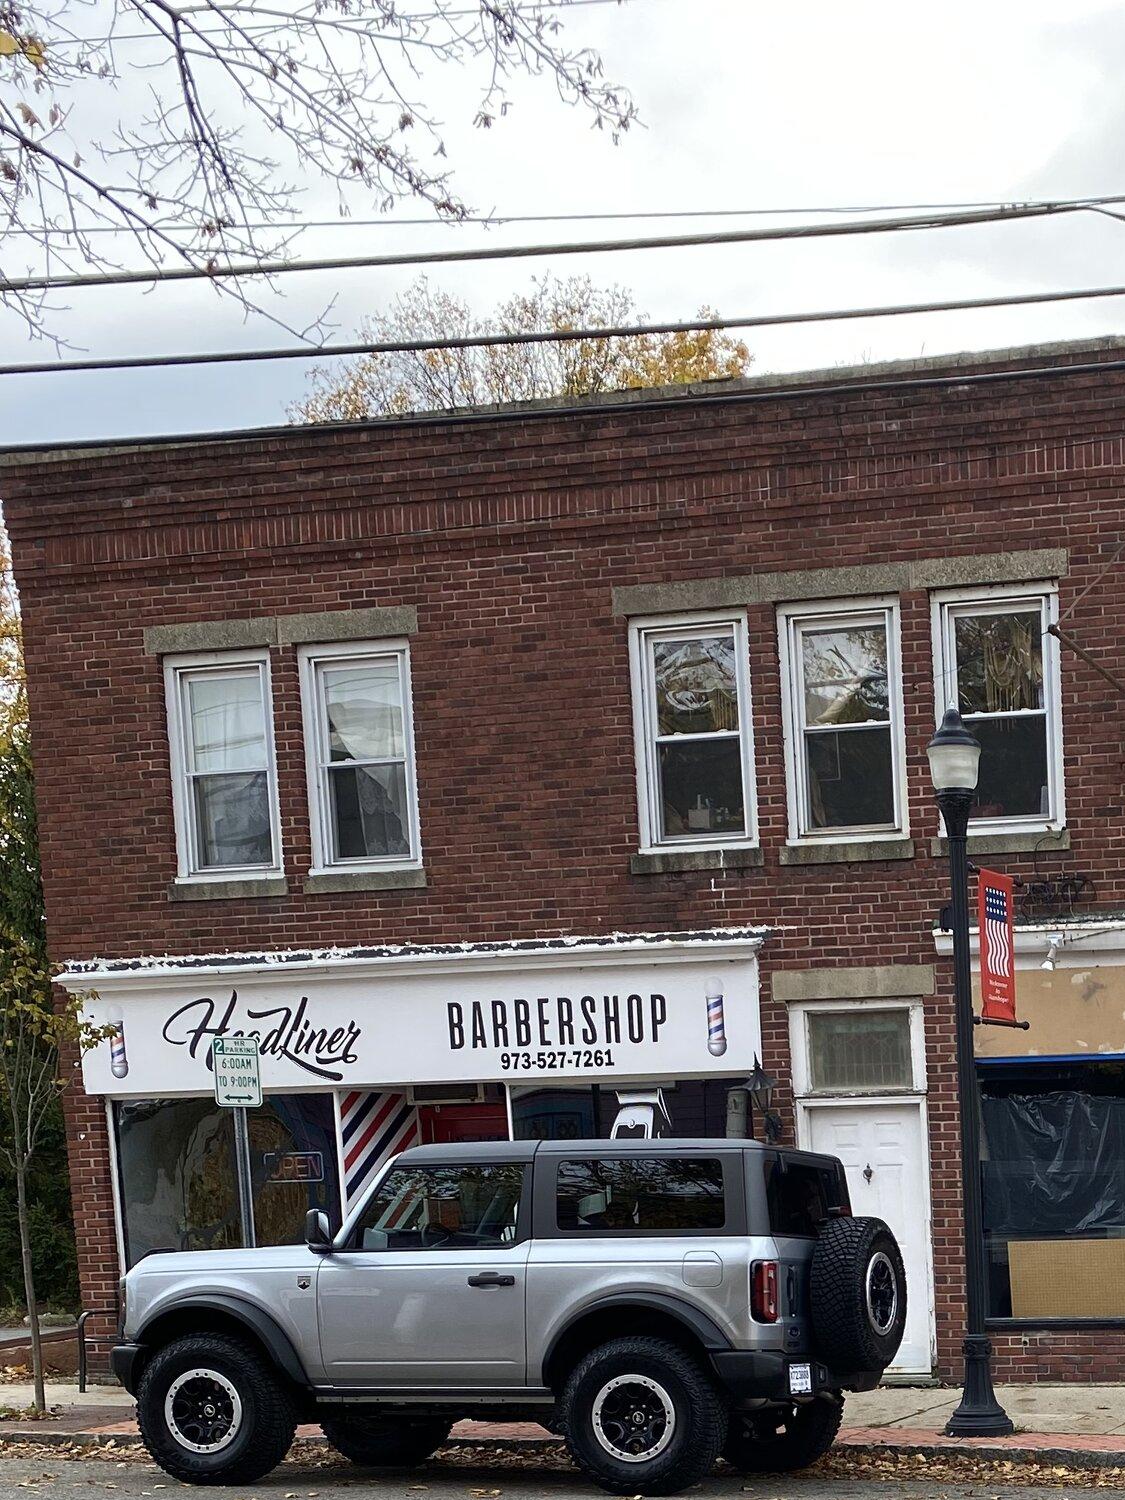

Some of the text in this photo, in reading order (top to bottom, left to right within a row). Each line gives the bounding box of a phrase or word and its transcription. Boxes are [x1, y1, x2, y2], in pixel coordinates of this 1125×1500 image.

[447, 994, 667, 1050] BARBERSHOP
[215, 1039, 224, 1054] 2
[222, 1058, 252, 1069] 6:00AM
[501, 1049, 615, 1070] 973-527-7261
[219, 1076, 257, 1088] TO 9:00PM
